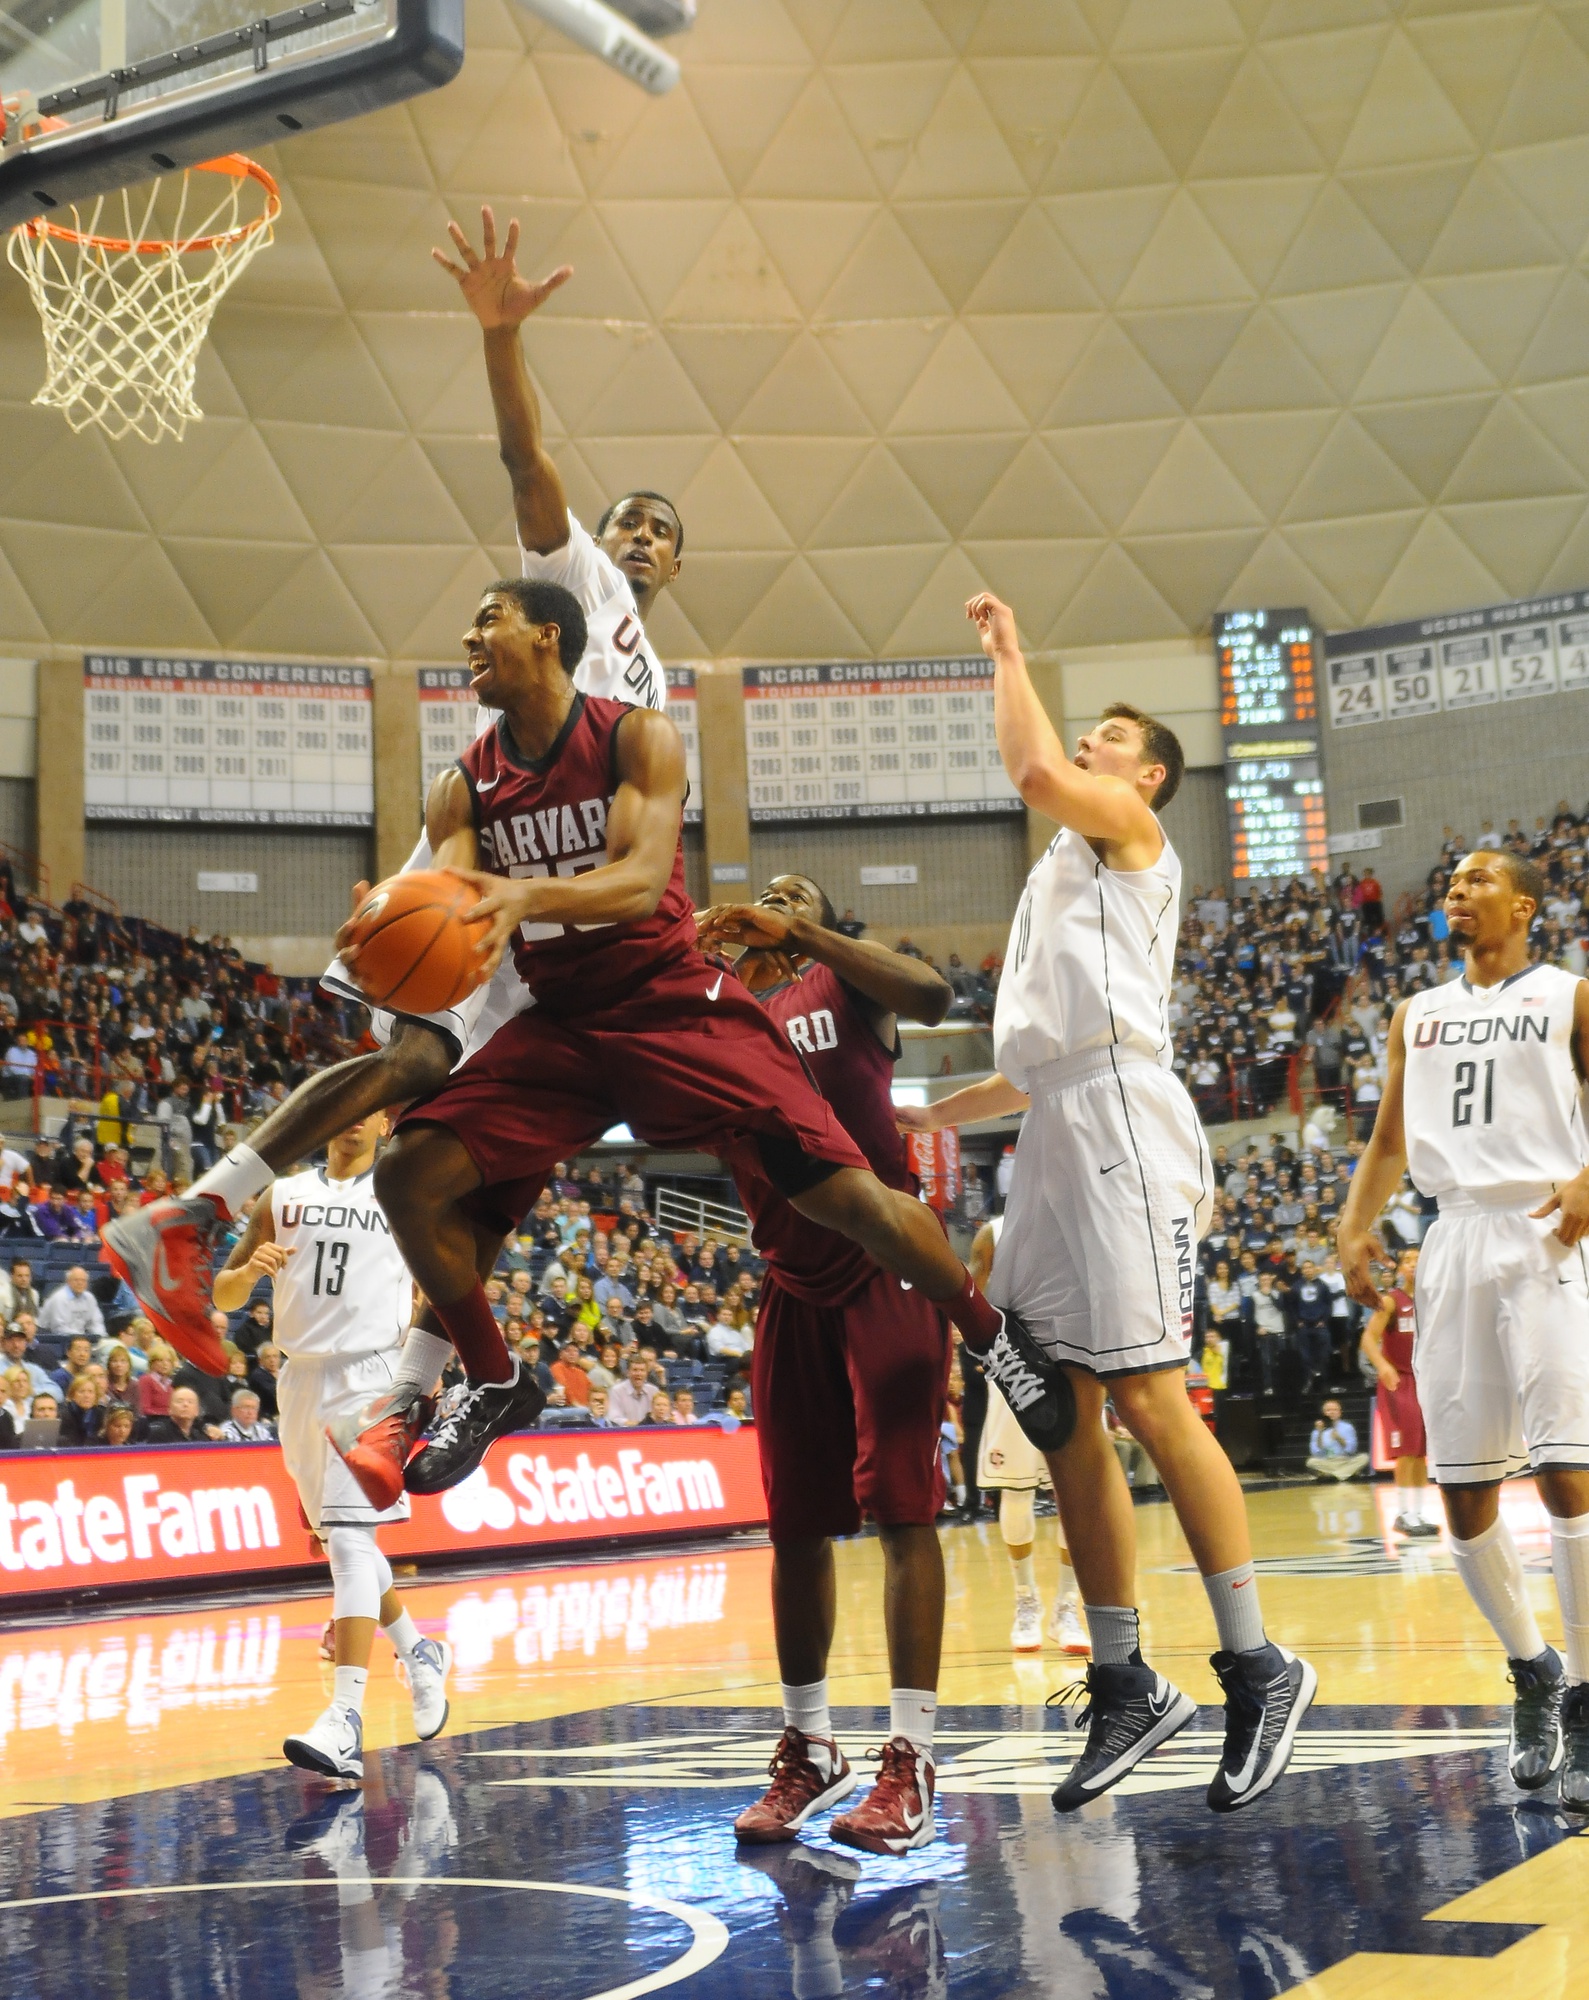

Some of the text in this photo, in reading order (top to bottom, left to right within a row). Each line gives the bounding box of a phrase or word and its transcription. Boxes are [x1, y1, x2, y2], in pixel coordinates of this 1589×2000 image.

[91, 657, 365, 685] BIG EAST CONFERENCE
[425, 671, 462, 687] BIG
[759, 668, 820, 683] NCAA
[1455, 665, 1484, 693] 21
[1511, 656, 1544, 683] 52
[758, 683, 870, 698] TOURNAMENT
[1338, 685, 1374, 713] 24
[1394, 676, 1430, 703] 50
[85, 806, 193, 820] CONNECTICUT
[274, 811, 371, 826] BASKETBALL
[752, 806, 852, 821] CONNECTICUT
[930, 800, 1023, 813] BASKETBALL
[895, 867, 911, 881] 14
[1413, 1015, 1549, 1049] UCONN
[1453, 1058, 1495, 1128] 21
[282, 1204, 391, 1235] UCONN
[312, 1241, 350, 1296] 13
[1171, 1217, 1194, 1340] UCONN
[507, 1449, 725, 1525] StateFarm
